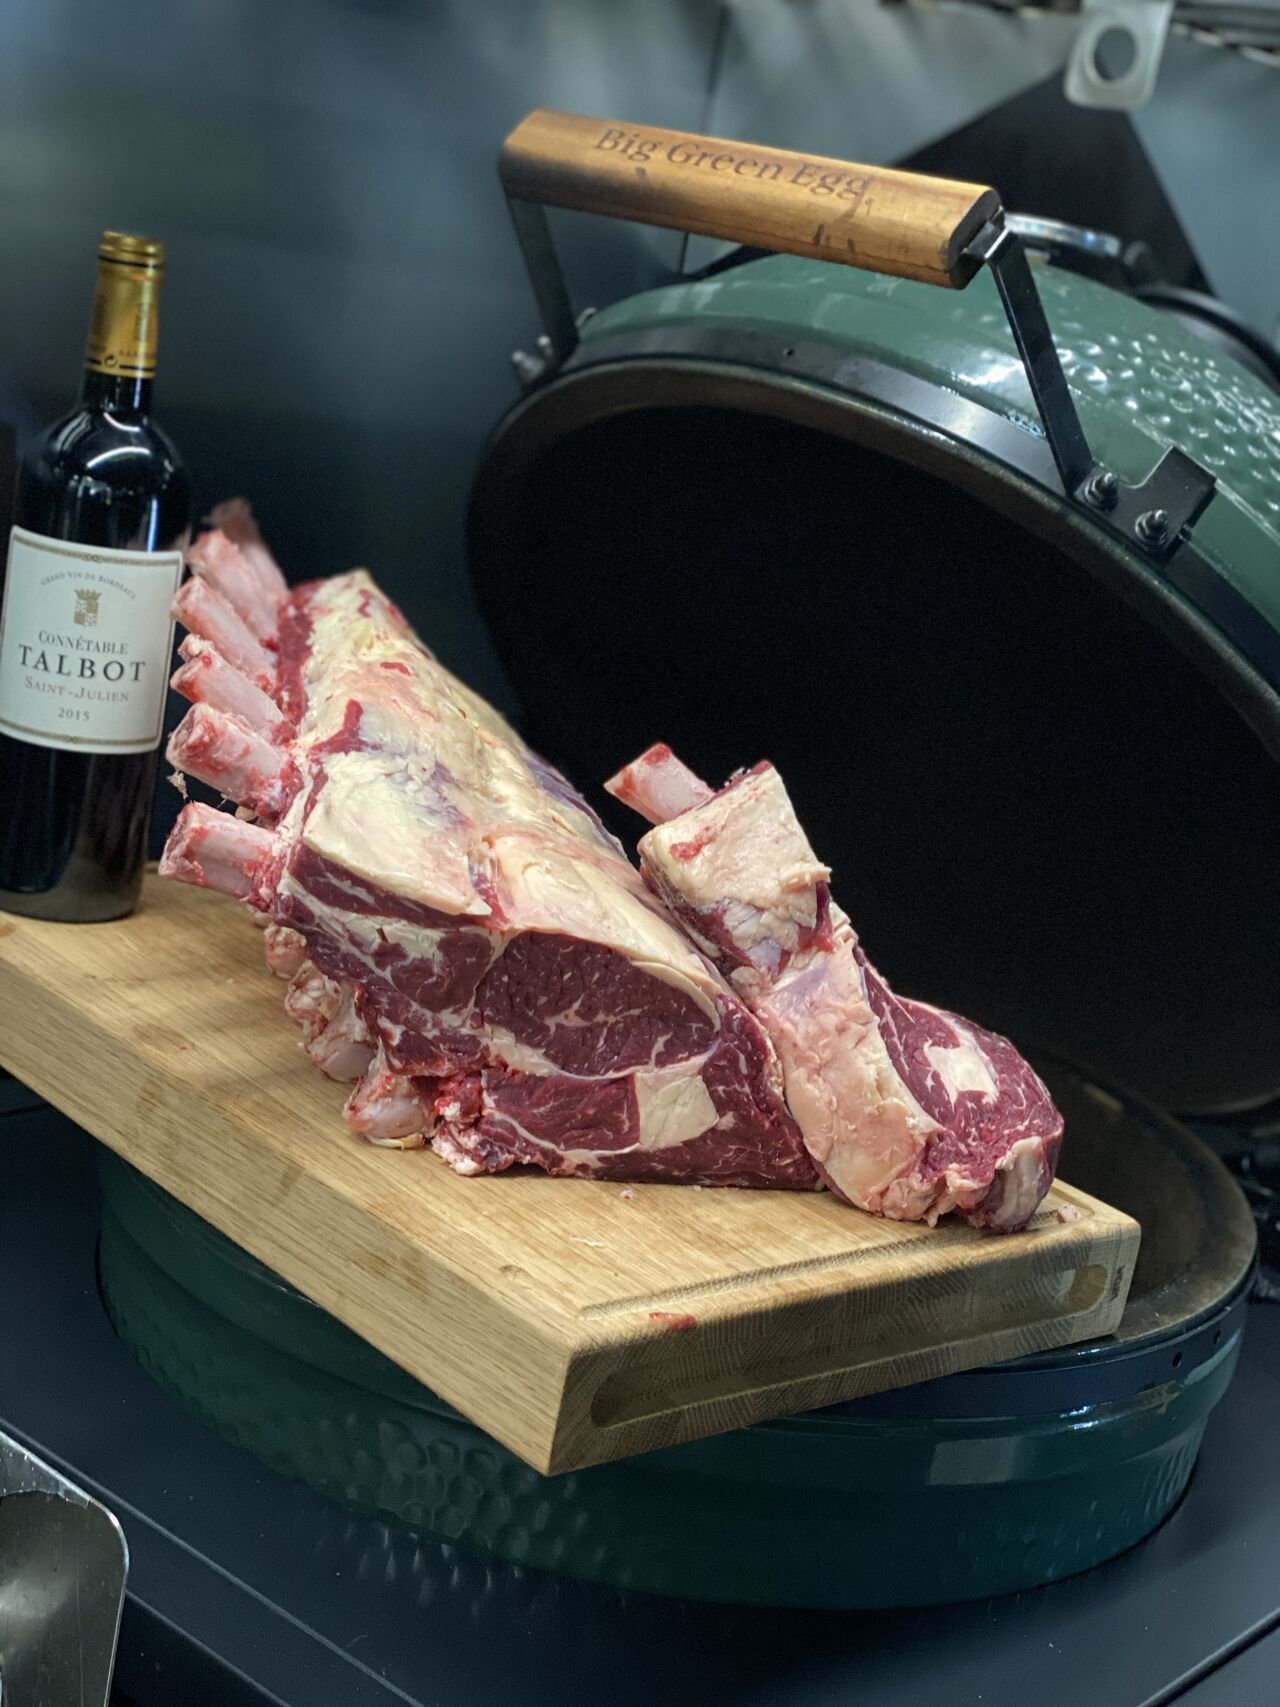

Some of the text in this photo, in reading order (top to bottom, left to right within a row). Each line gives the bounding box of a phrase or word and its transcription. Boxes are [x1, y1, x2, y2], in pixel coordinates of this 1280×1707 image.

[594, 128, 868, 200] Big Green Egg
[18, 643, 147, 682] TALBOT
[57, 706, 91, 722] 2015
